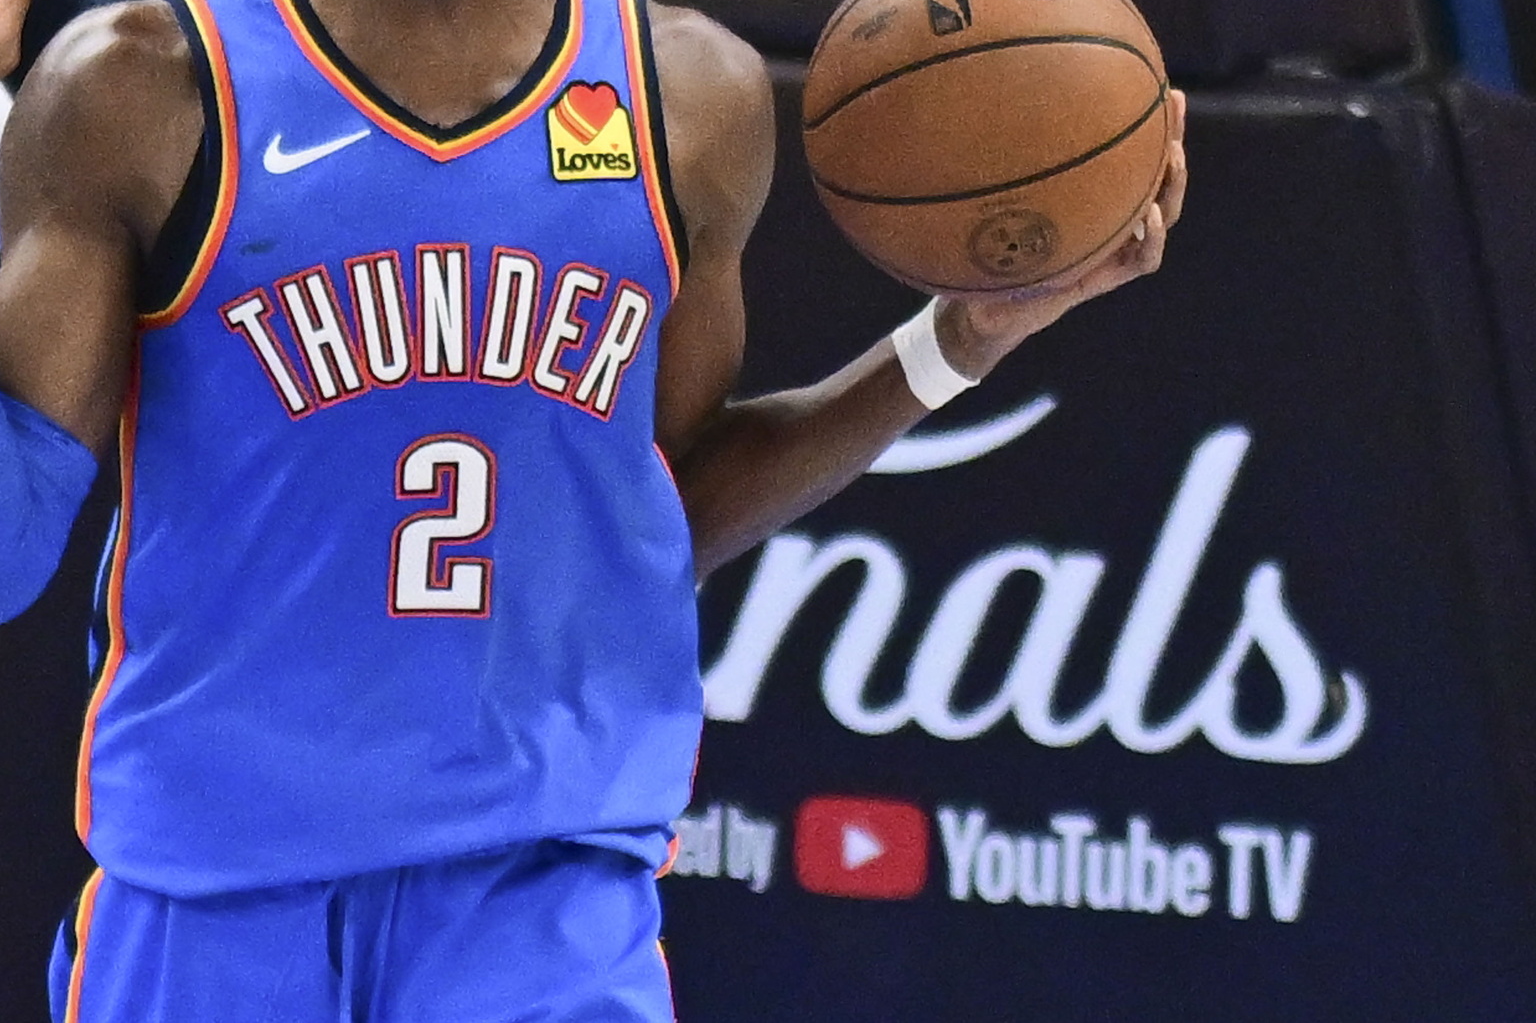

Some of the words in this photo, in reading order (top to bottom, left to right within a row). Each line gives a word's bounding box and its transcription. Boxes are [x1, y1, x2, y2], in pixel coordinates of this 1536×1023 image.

[220, 244, 652, 421] THUNDER
[388, 434, 497, 618] 2
[703, 393, 1367, 765] nals
[725, 804, 776, 894] by
[937, 807, 1214, 918] YouTube
[1218, 824, 1312, 923] TV
